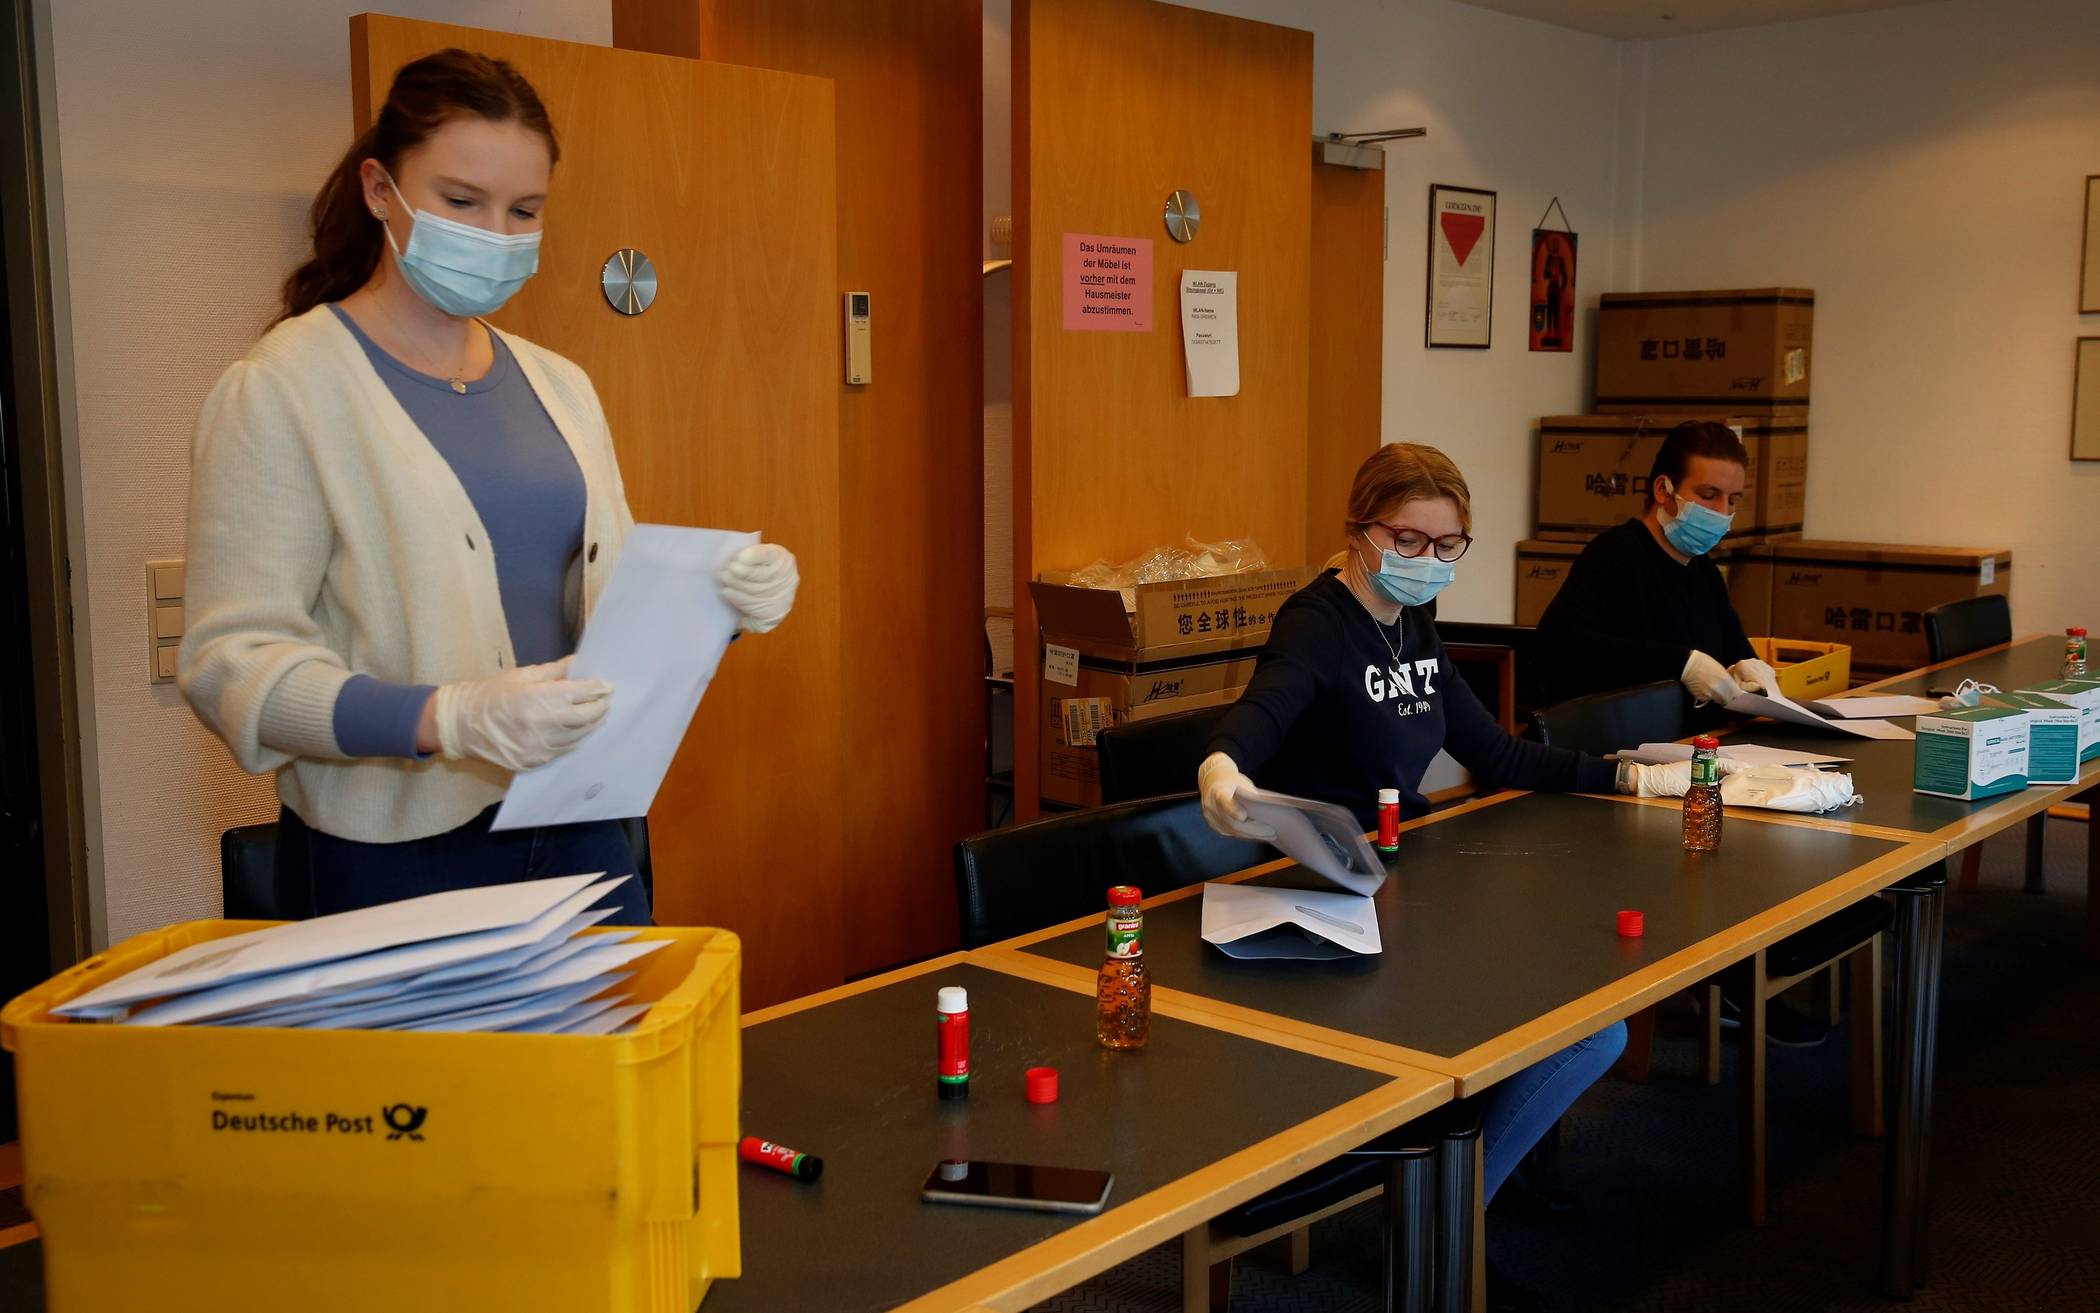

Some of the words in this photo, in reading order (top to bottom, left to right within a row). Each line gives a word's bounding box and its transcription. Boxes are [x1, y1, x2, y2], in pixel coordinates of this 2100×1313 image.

[1080, 242, 1094, 253] Das
[1096, 243, 1137, 255] Umräumen
[1083, 258, 1096, 268] der
[1097, 259, 1120, 269] Möbel
[1121, 260, 1131, 270] ist
[1080, 274, 1105, 284] vorher
[1106, 275, 1118, 285] mit
[1119, 275, 1136, 285] dem
[1085, 289, 1131, 300] Hausmeister
[1082, 304, 1134, 316] abzustimmen.
[1398, 702, 1413, 716] Est.
[212, 1110, 319, 1132] Deutsche
[325, 1113, 374, 1134] Post
